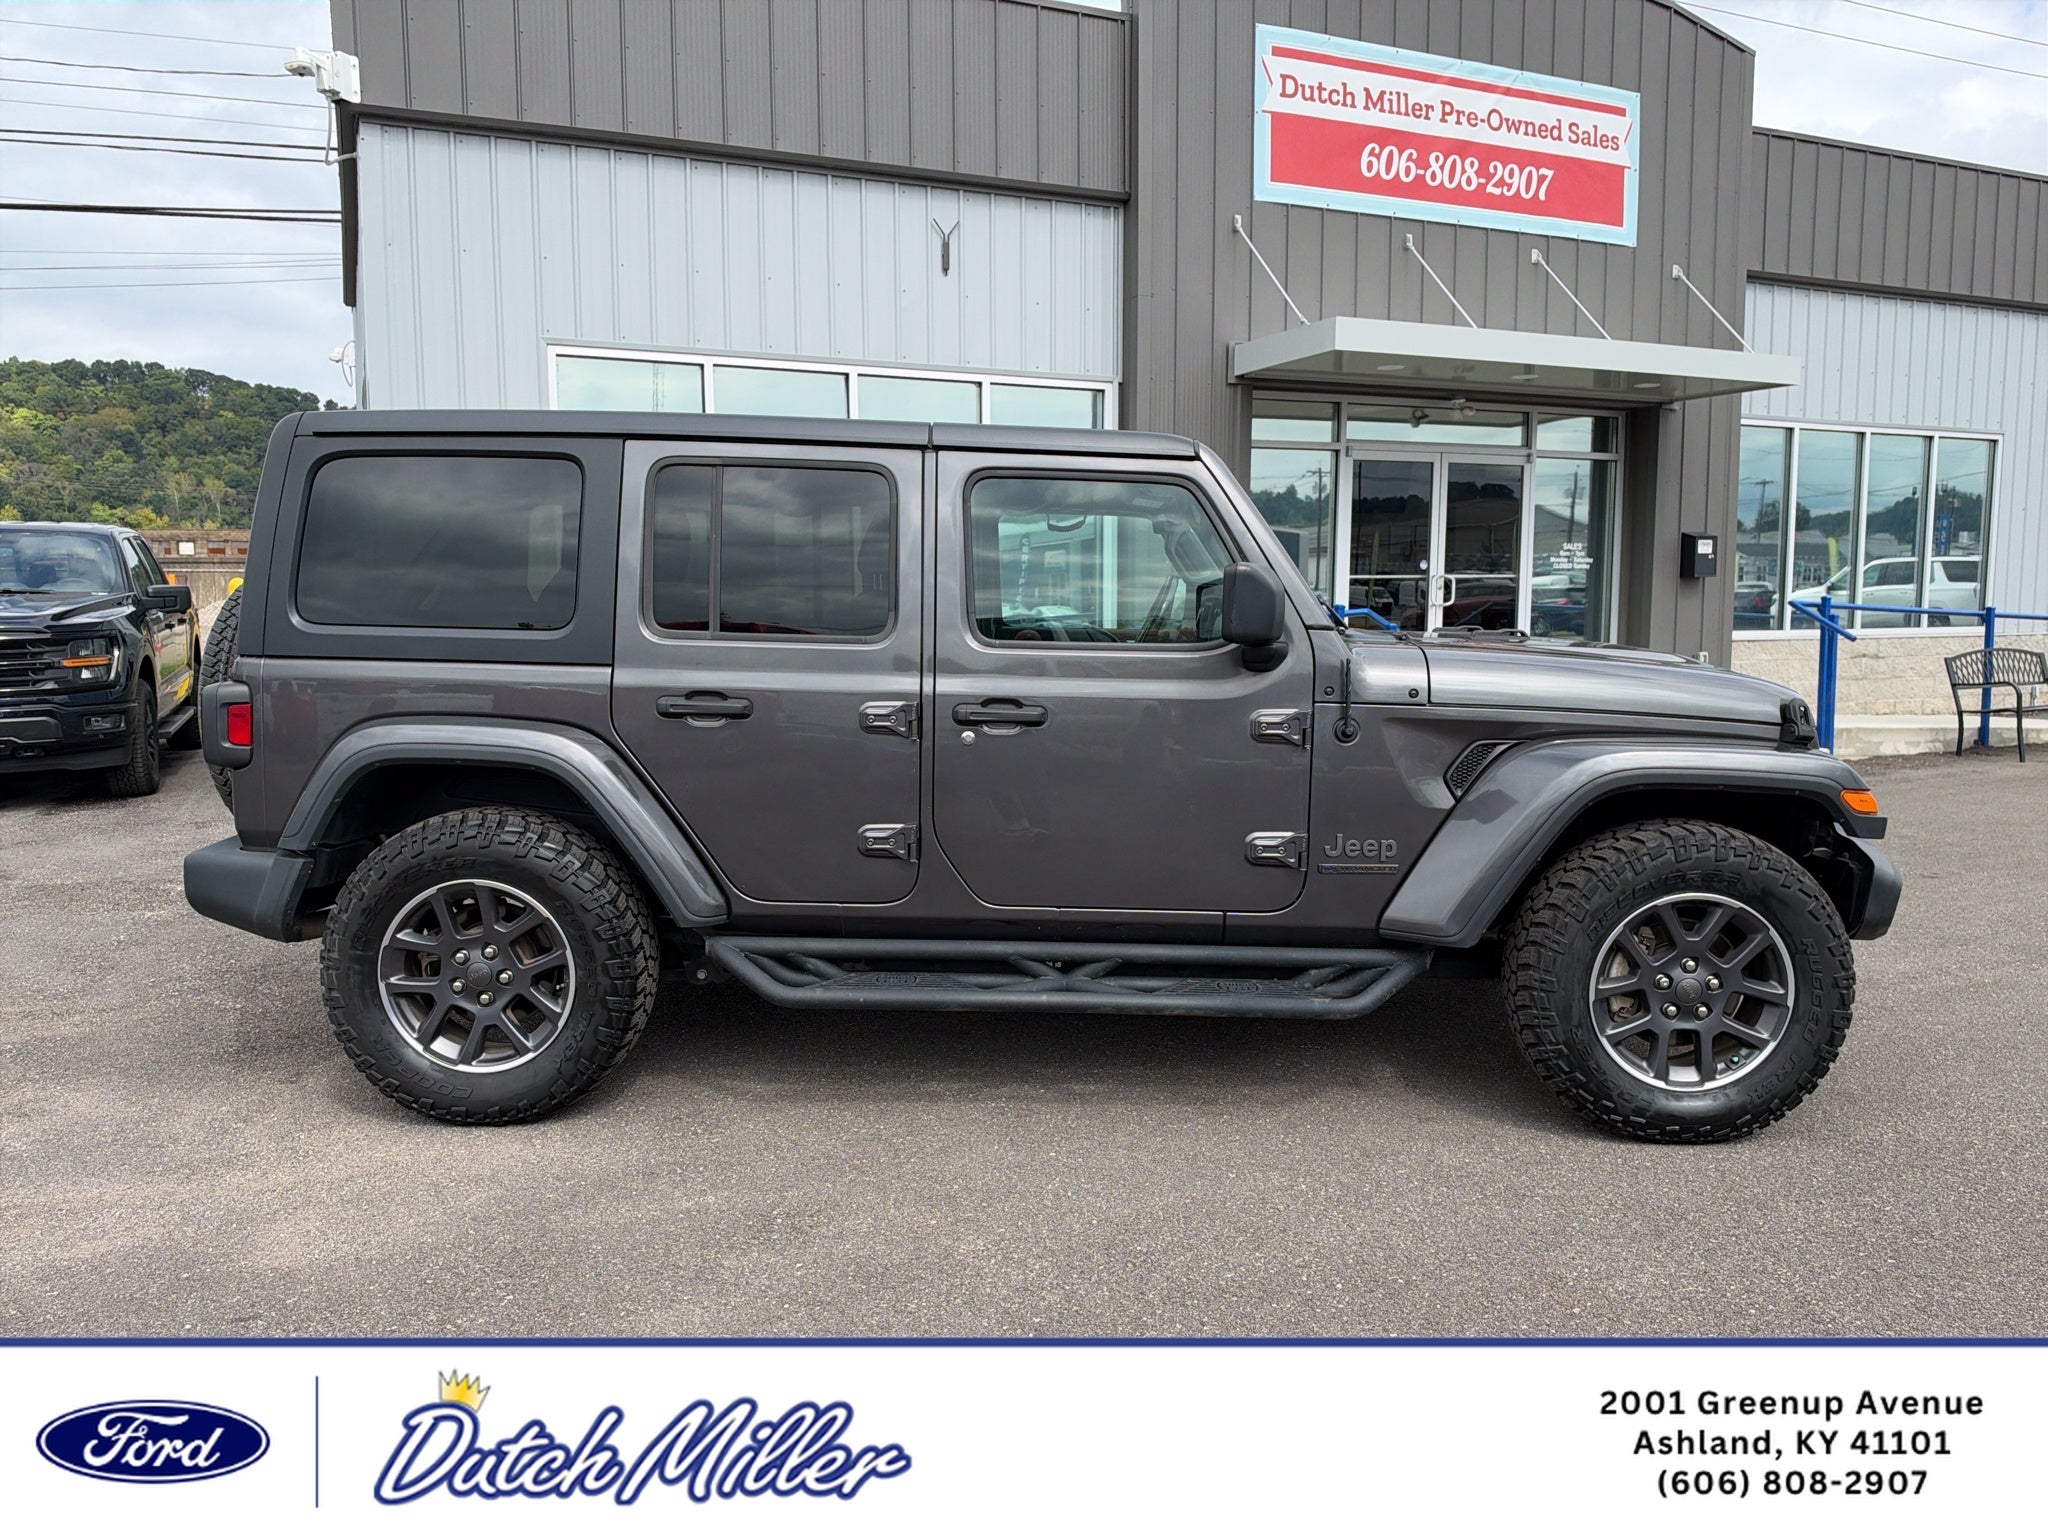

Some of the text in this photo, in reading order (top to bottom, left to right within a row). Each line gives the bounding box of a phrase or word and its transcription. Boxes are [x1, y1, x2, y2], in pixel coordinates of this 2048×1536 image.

[1279, 73, 1620, 151] Dutch Miller Pre-Owned Sales
[1360, 142, 1554, 200] 606-808-2907
[1562, 542, 1582, 550] SALES
[1324, 833, 1398, 861] Jeep
[1802, 938, 1824, 1044] RUGGED
